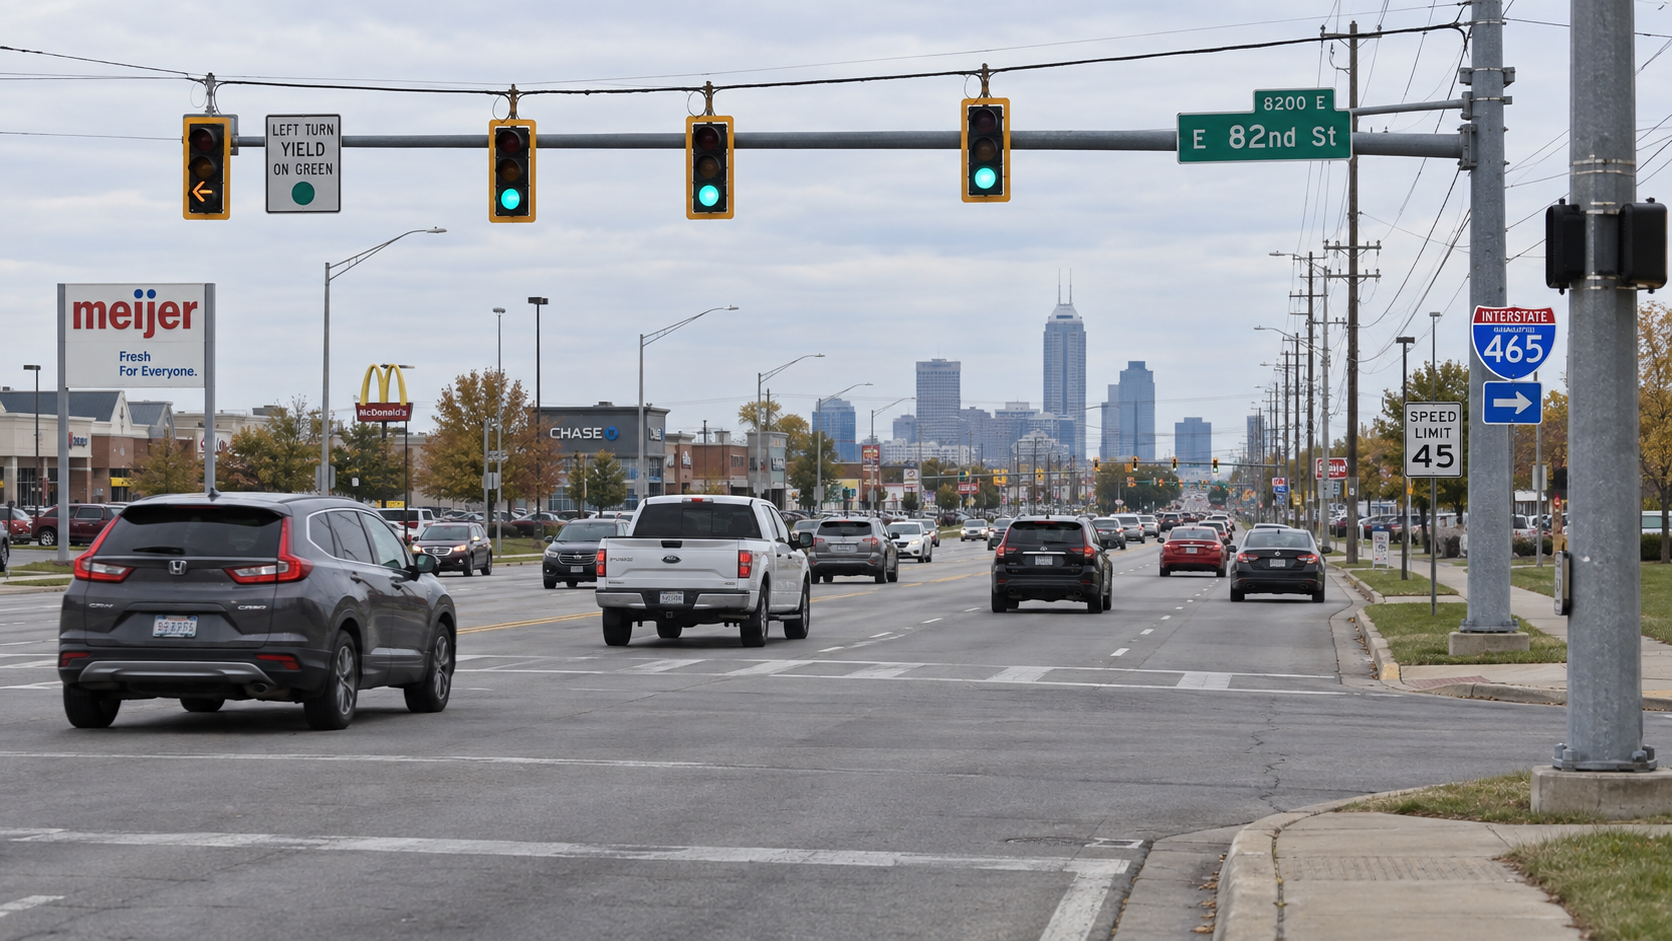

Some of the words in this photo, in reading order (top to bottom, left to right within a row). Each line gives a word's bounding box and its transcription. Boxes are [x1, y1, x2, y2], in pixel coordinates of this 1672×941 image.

[1263, 96, 1306, 111] 8200
[1316, 95, 1326, 110] E
[272, 124, 299, 136] LEFT
[305, 123, 334, 136] TURN
[1193, 129, 1206, 149] E
[1229, 124, 1296, 149] 82nd
[1311, 126, 1336, 147] St
[281, 142, 325, 157] YIELD
[273, 163, 289, 176] ON
[295, 163, 333, 175] GREEN
[73, 288, 198, 339] meijer
[1482, 310, 1548, 322] INTERSTATE
[1483, 334, 1543, 363] 465
[119, 351, 151, 362] Fresh
[119, 365, 138, 377] For
[141, 365, 198, 379] Everyone.
[359, 408, 407, 417] McDonald's
[1410, 411, 1457, 423] SPEED
[549, 427, 603, 439] CHASE
[1415, 427, 1452, 439] LIMIT
[1411, 444, 1455, 469] 45
